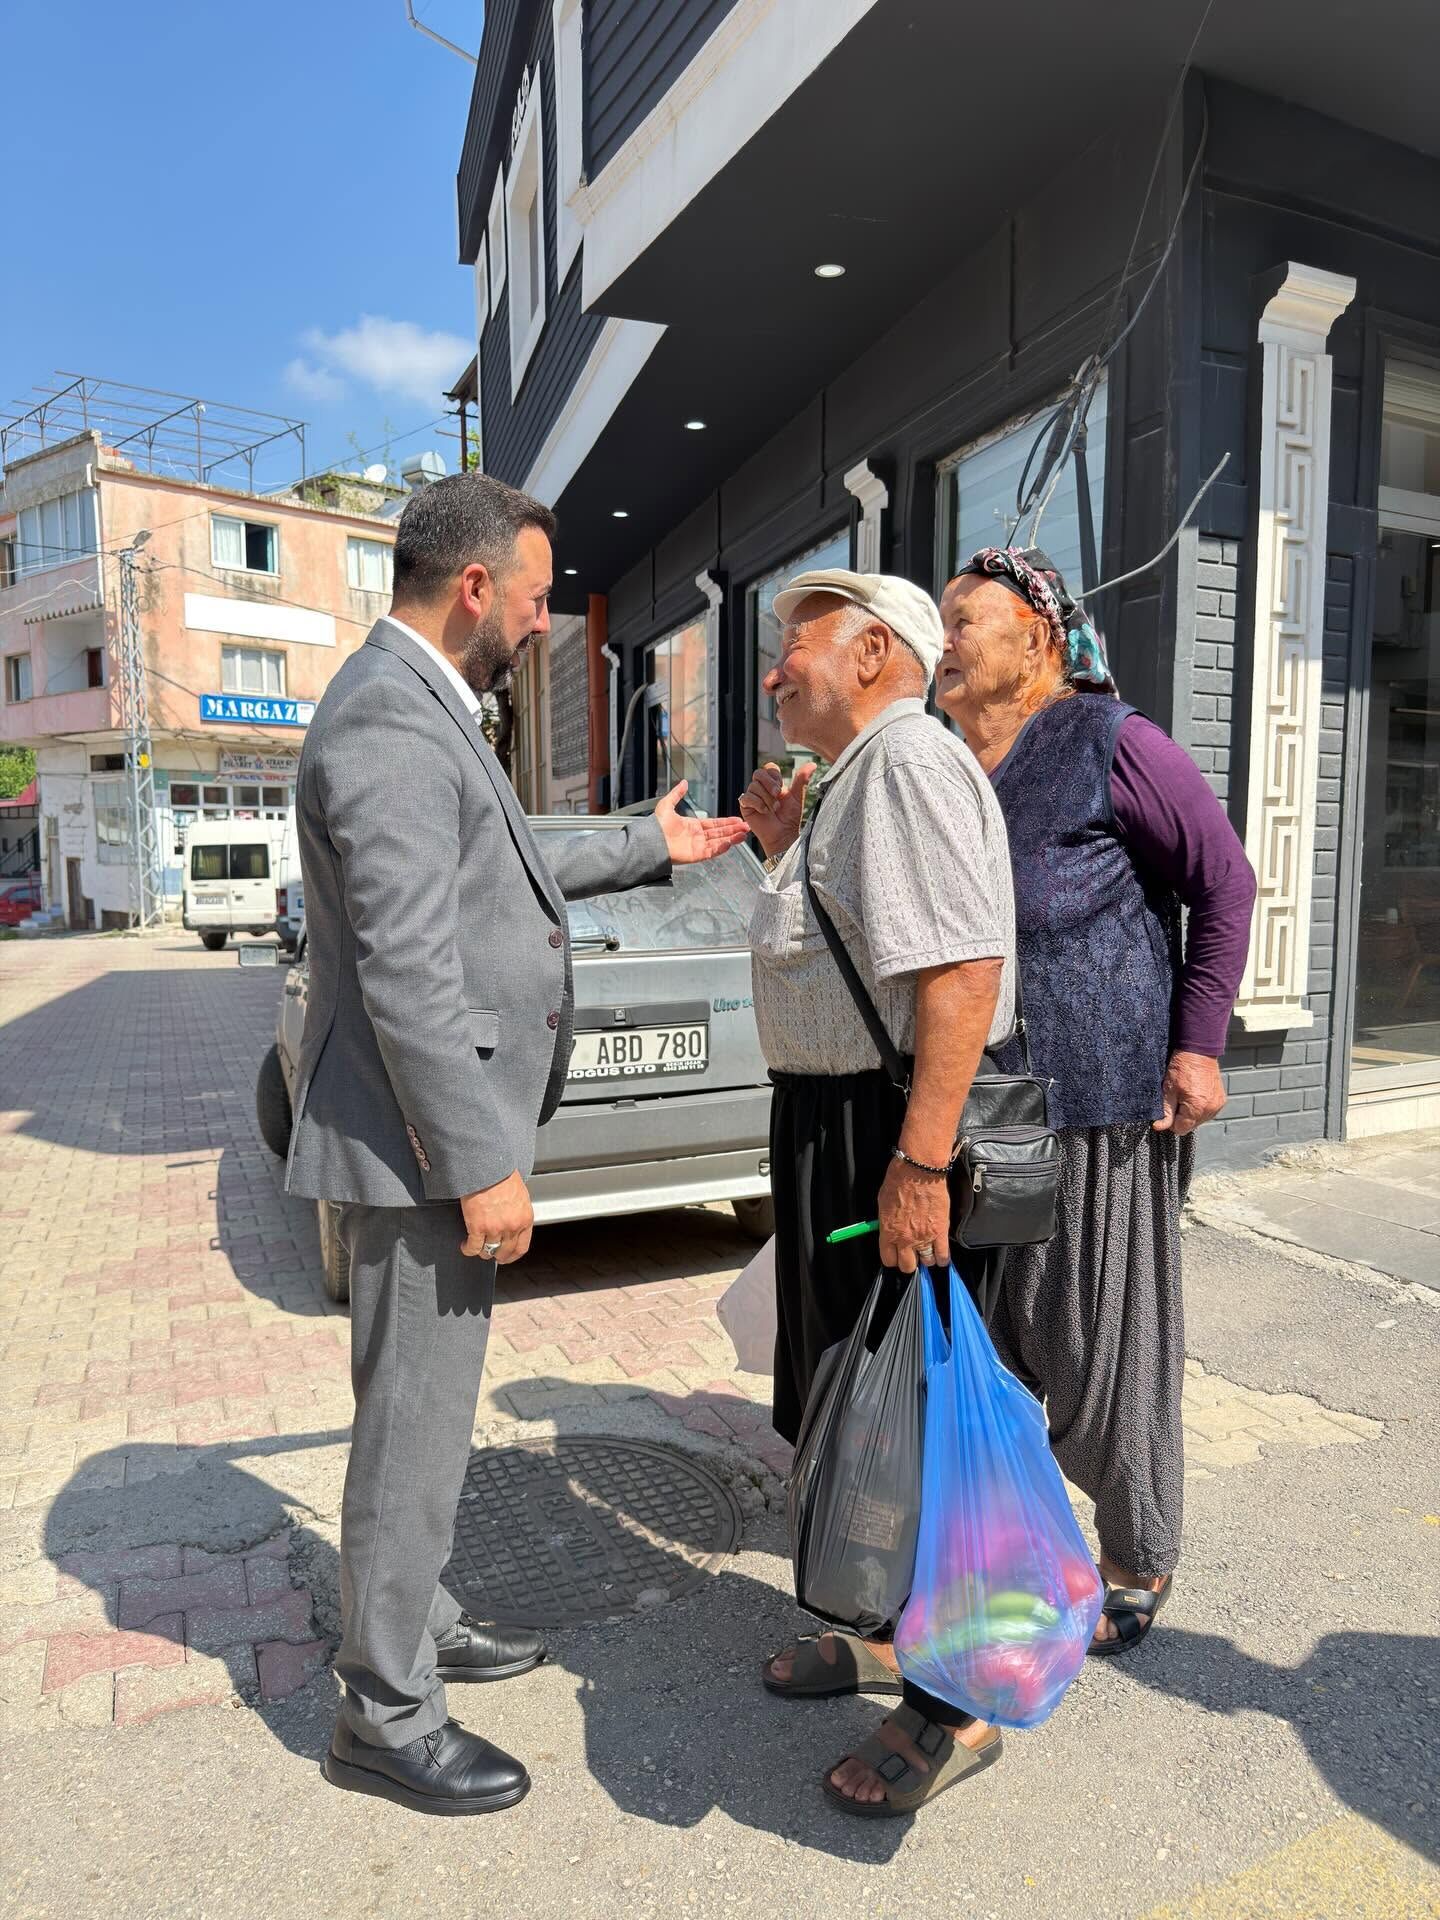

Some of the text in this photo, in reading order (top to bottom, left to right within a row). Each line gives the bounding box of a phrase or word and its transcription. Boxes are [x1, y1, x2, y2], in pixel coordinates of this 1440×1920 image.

[206, 697, 297, 721] MARGAZ
[597, 1034, 643, 1065] ABD
[656, 1029, 702, 1060] 780
[623, 1063, 657, 1075] OTO
